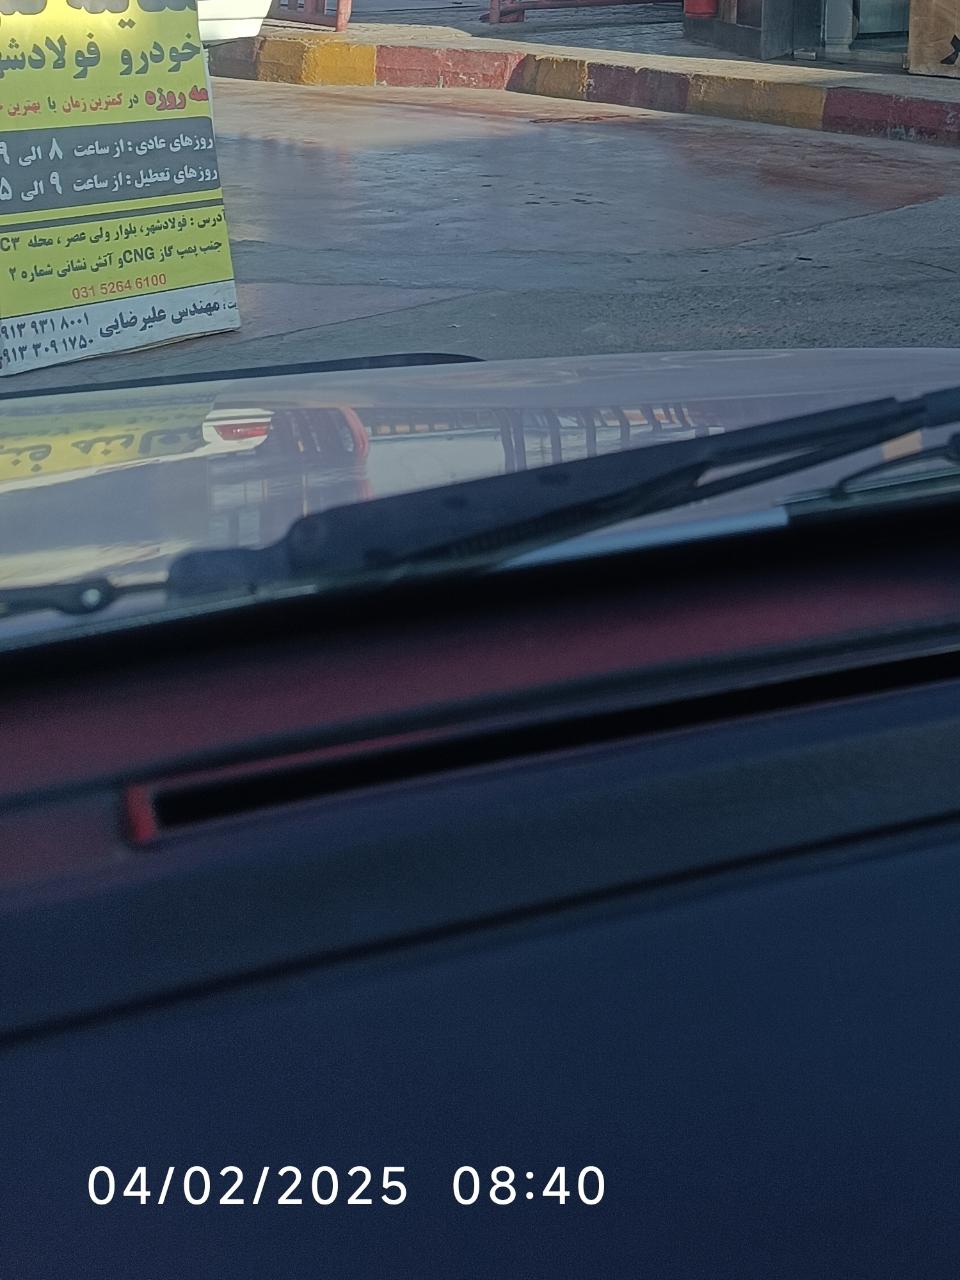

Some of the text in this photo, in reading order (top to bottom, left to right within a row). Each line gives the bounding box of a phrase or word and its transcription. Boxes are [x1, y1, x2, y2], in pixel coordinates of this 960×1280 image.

[119, 33, 200, 76] خودرو
[7, 99, 41, 117] بهترین
[47, 96, 57, 114] با
[62, 96, 87, 113] زمان
[89, 93, 123, 112] کمترین
[127, 94, 139, 109] در
[144, 87, 187, 111] روزه
[48, 137, 63, 161] ۸
[73, 140, 110, 157] ساعت
[112, 138, 125, 159] از
[169, 133, 214, 153] روزهای
[18, 145, 42, 167] الی
[49, 171, 63, 195] ۹
[72, 174, 109, 192] ساعت
[112, 172, 123, 192] از
[173, 164, 219, 185] روزهای
[20, 180, 44, 202] الی
[114, 223, 137, 241] بلوار
[27, 235, 54, 249] محله
[198, 239, 223, 255] جنب
[90, 253, 114, 272] آتش
[158, 245, 174, 262] گاز
[20, 267, 54, 282] شماره
[57, 260, 87, 278] نشانی
[72, 273, 167, 300] 031 5264 6100
[171, 299, 220, 324] مهندس
[31, 318, 55, 334] ۹۳۱
[61, 312, 89, 330] ۸۰۰۱
[32, 339, 58, 358] ۳۰۹
[62, 334, 94, 352] ۱۷۵۰
